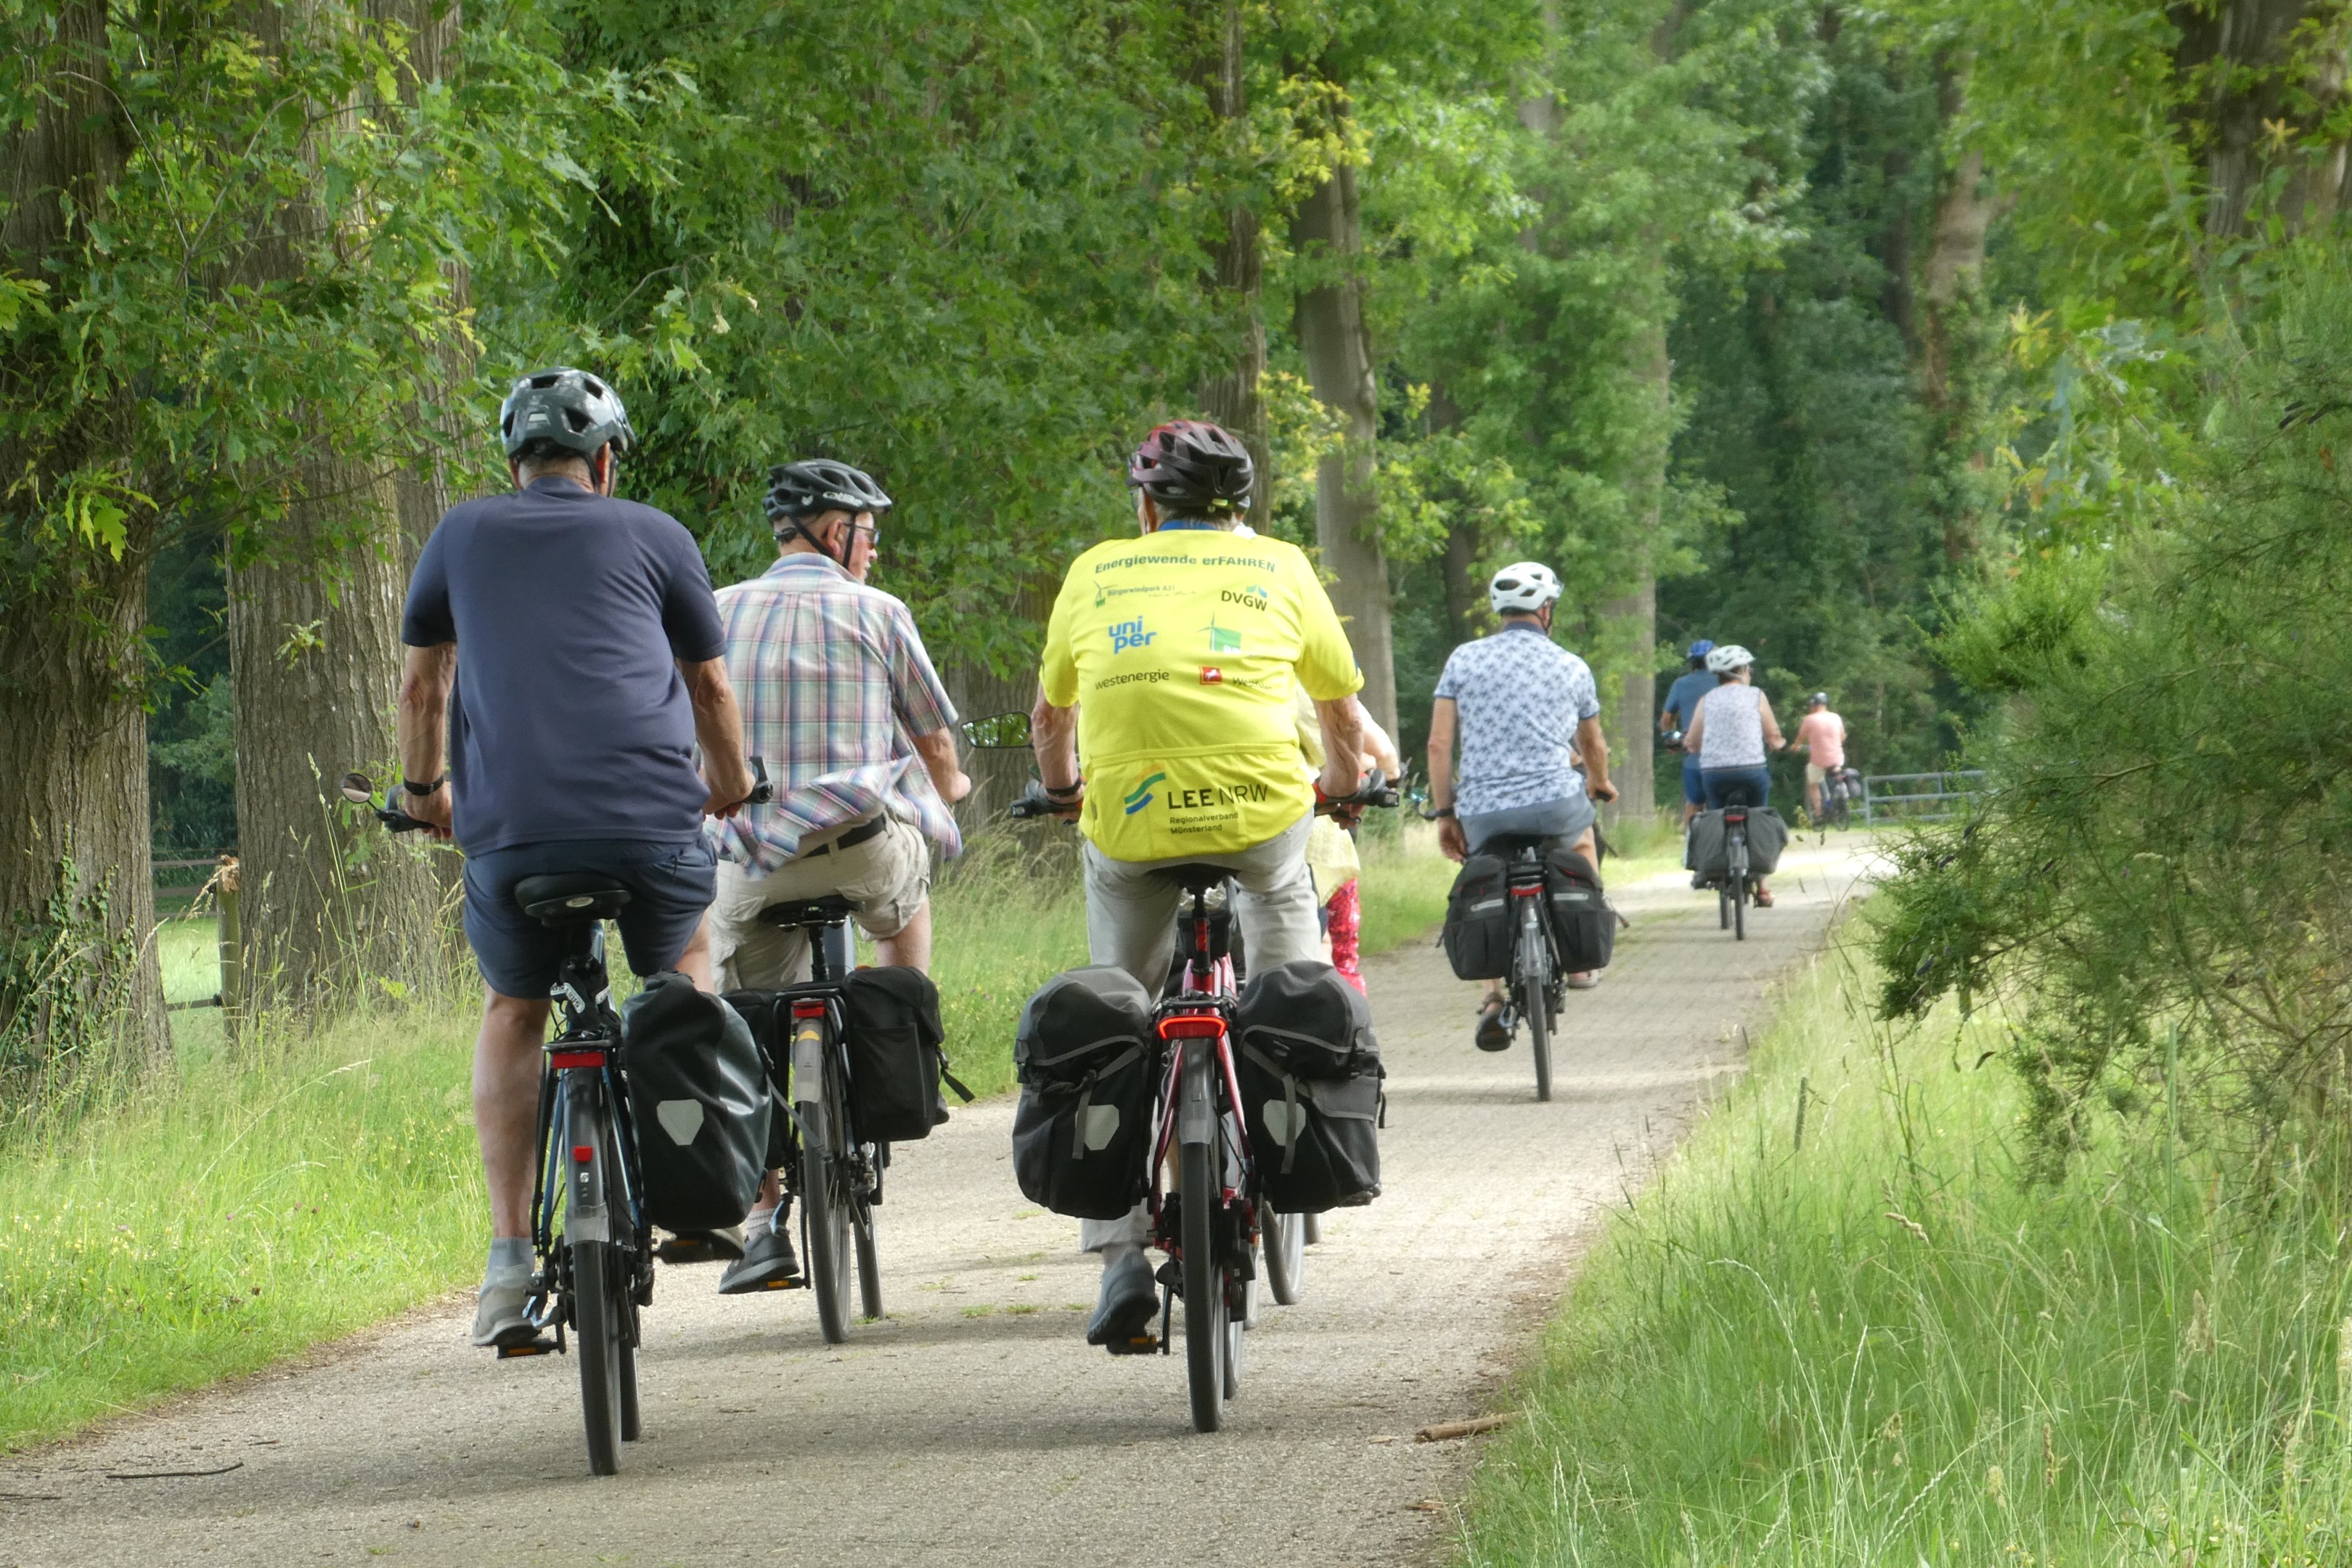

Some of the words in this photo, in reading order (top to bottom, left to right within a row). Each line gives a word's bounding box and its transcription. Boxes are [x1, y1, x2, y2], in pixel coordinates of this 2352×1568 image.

[1095, 555, 1197, 573] Energiewende
[1202, 556, 1275, 573] erFAHREN
[1221, 589, 1267, 611] DVGW
[1108, 616, 1143, 637] uni
[1114, 632, 1157, 654] per
[1095, 669, 1169, 690] westenergie
[1167, 788, 1214, 809] LEE
[1220, 784, 1268, 806] NRW
[1169, 812, 1239, 825] Regionalverband
[1170, 824, 1222, 835] Münsterland
